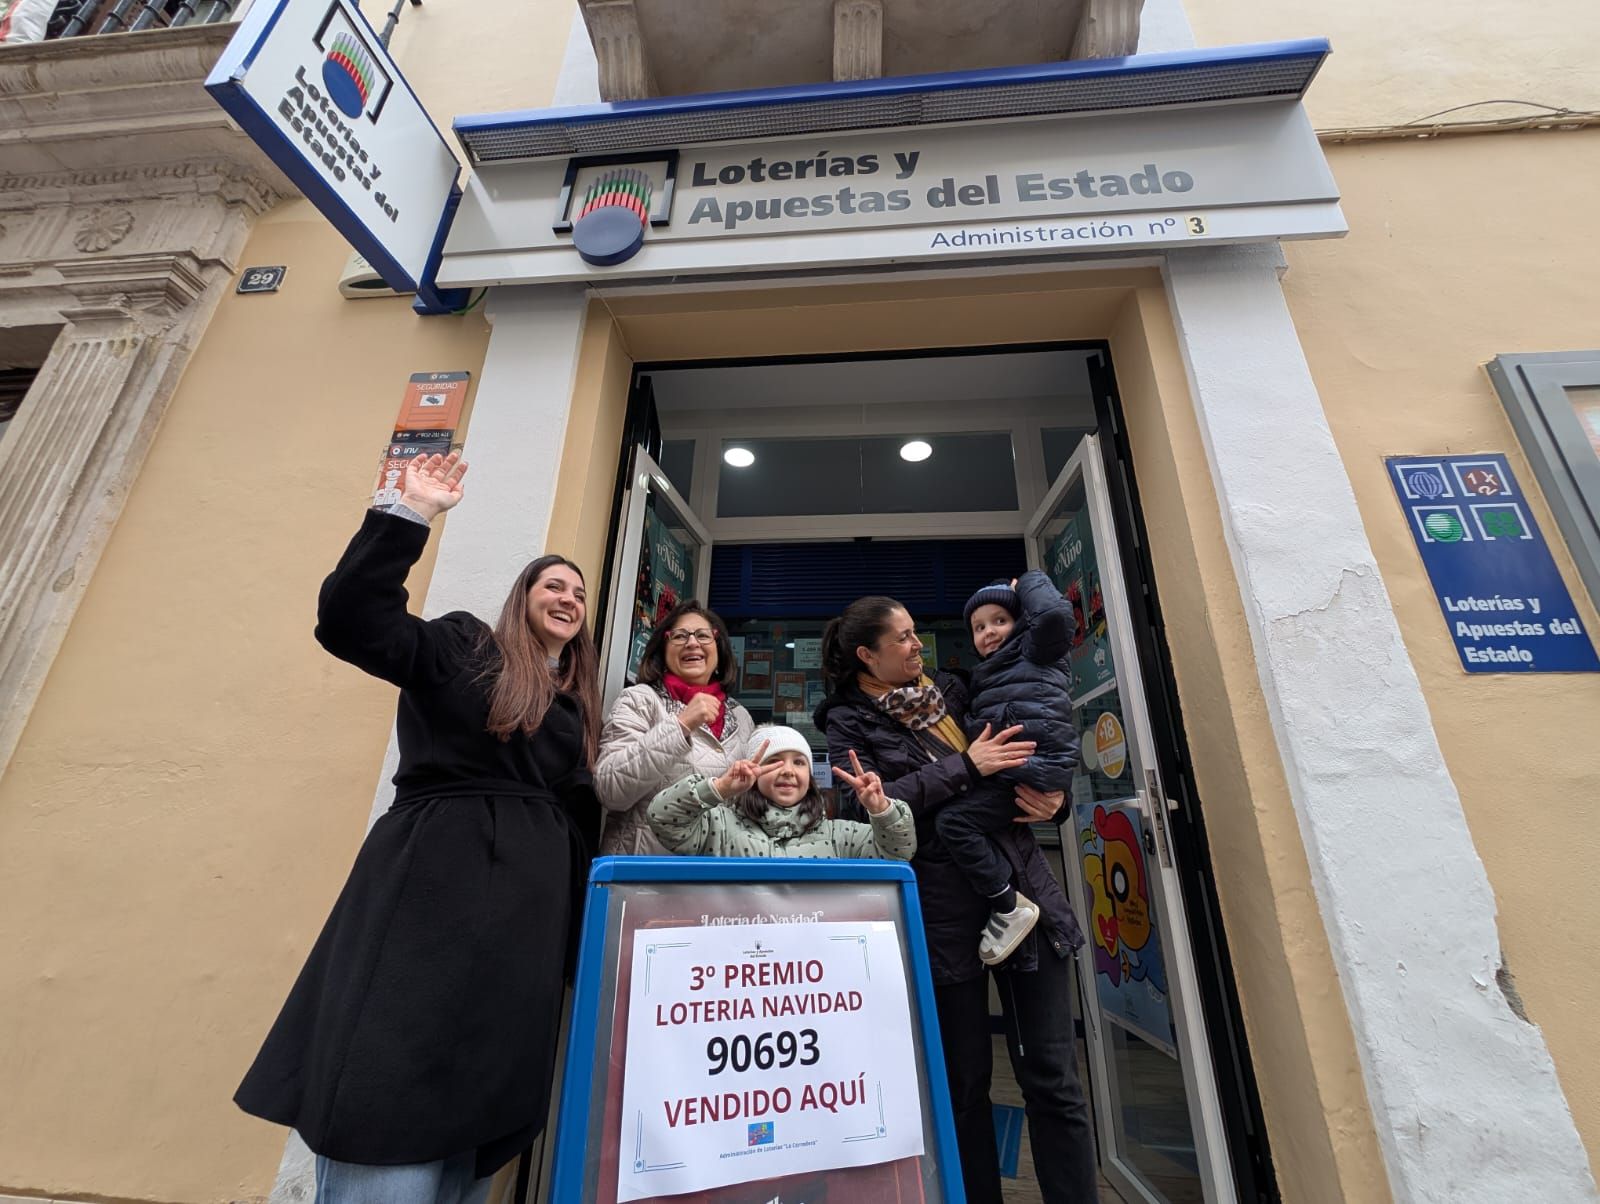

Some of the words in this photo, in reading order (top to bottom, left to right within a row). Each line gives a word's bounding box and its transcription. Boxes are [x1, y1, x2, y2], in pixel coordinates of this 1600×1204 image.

[277, 97, 346, 182] Estado
[286, 86, 372, 190] Apuestas
[374, 191, 399, 222] del
[369, 164, 381, 180] y
[692, 151, 879, 187] Loterías
[894, 151, 920, 180] y
[688, 186, 911, 230] Apuestas
[926, 174, 1001, 209] del
[1015, 164, 1194, 203] Estado
[930, 222, 1133, 248] Administración
[1189, 217, 1205, 235] 3
[248, 273, 274, 285] 29
[1444, 595, 1525, 612] Loterías
[1527, 598, 1540, 614] y
[1456, 621, 1545, 640] Apuestas
[1549, 618, 1582, 635] del
[1464, 646, 1533, 663] Estado
[1100, 719, 1115, 741] +18
[724, 959, 824, 989] PREMIO
[656, 997, 755, 1027] LOTERIA
[762, 990, 863, 1019] NAVIDAD
[706, 1028, 820, 1076] 90693
[664, 1086, 792, 1129] VENDIDO
[800, 1072, 867, 1114] AQUÍ
